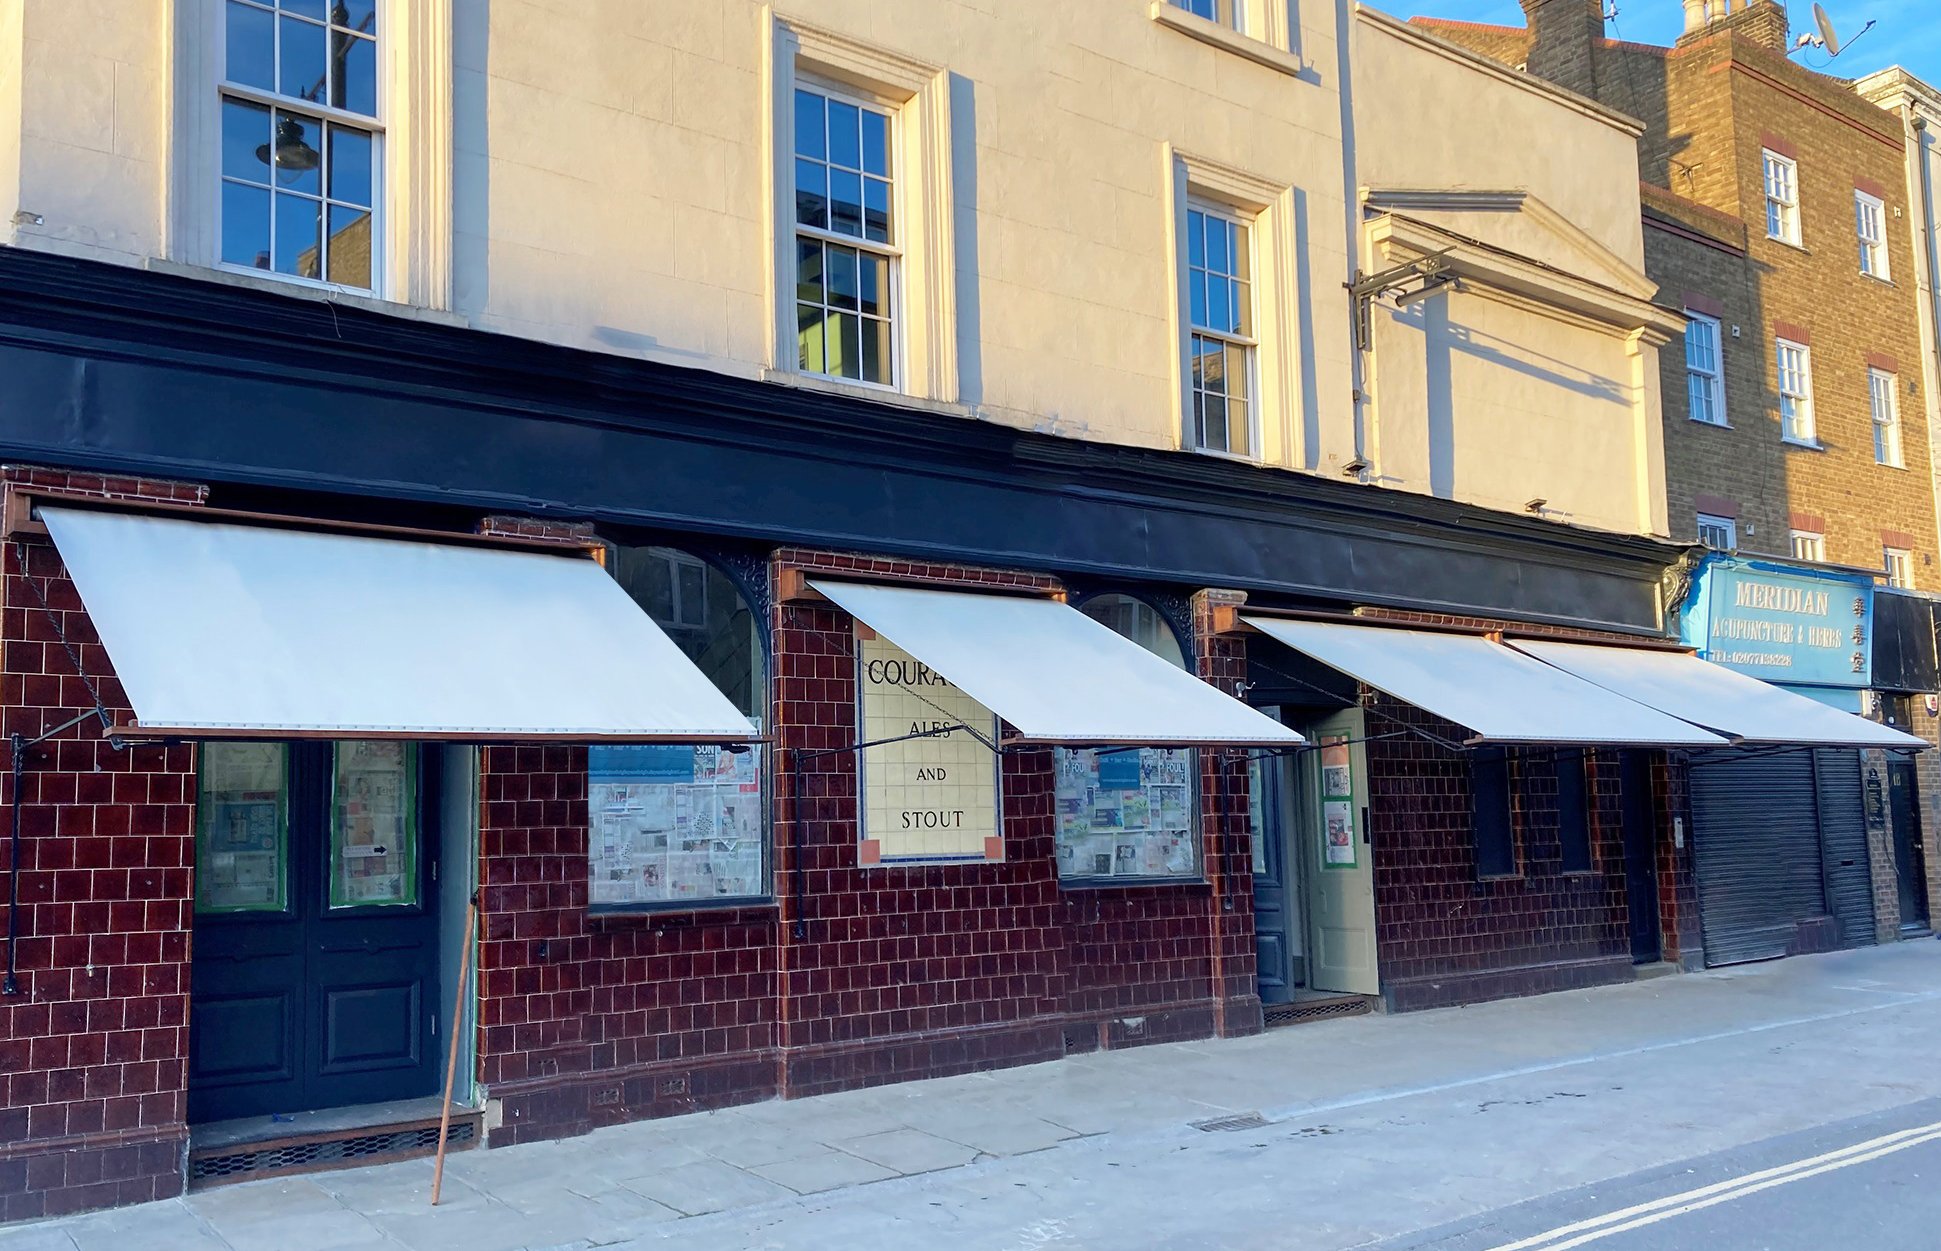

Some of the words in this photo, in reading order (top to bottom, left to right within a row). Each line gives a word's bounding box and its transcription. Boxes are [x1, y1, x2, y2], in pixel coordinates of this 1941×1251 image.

[1735, 581, 1829, 616] MERIDIAN
[1712, 616, 1793, 644] ACUPUNCTURE
[1808, 627, 1842, 648] HERBS
[868, 659, 957, 688] COURA
[909, 721, 951, 738] ALES
[916, 768, 947, 781] AND
[901, 811, 964, 829] STOUT
